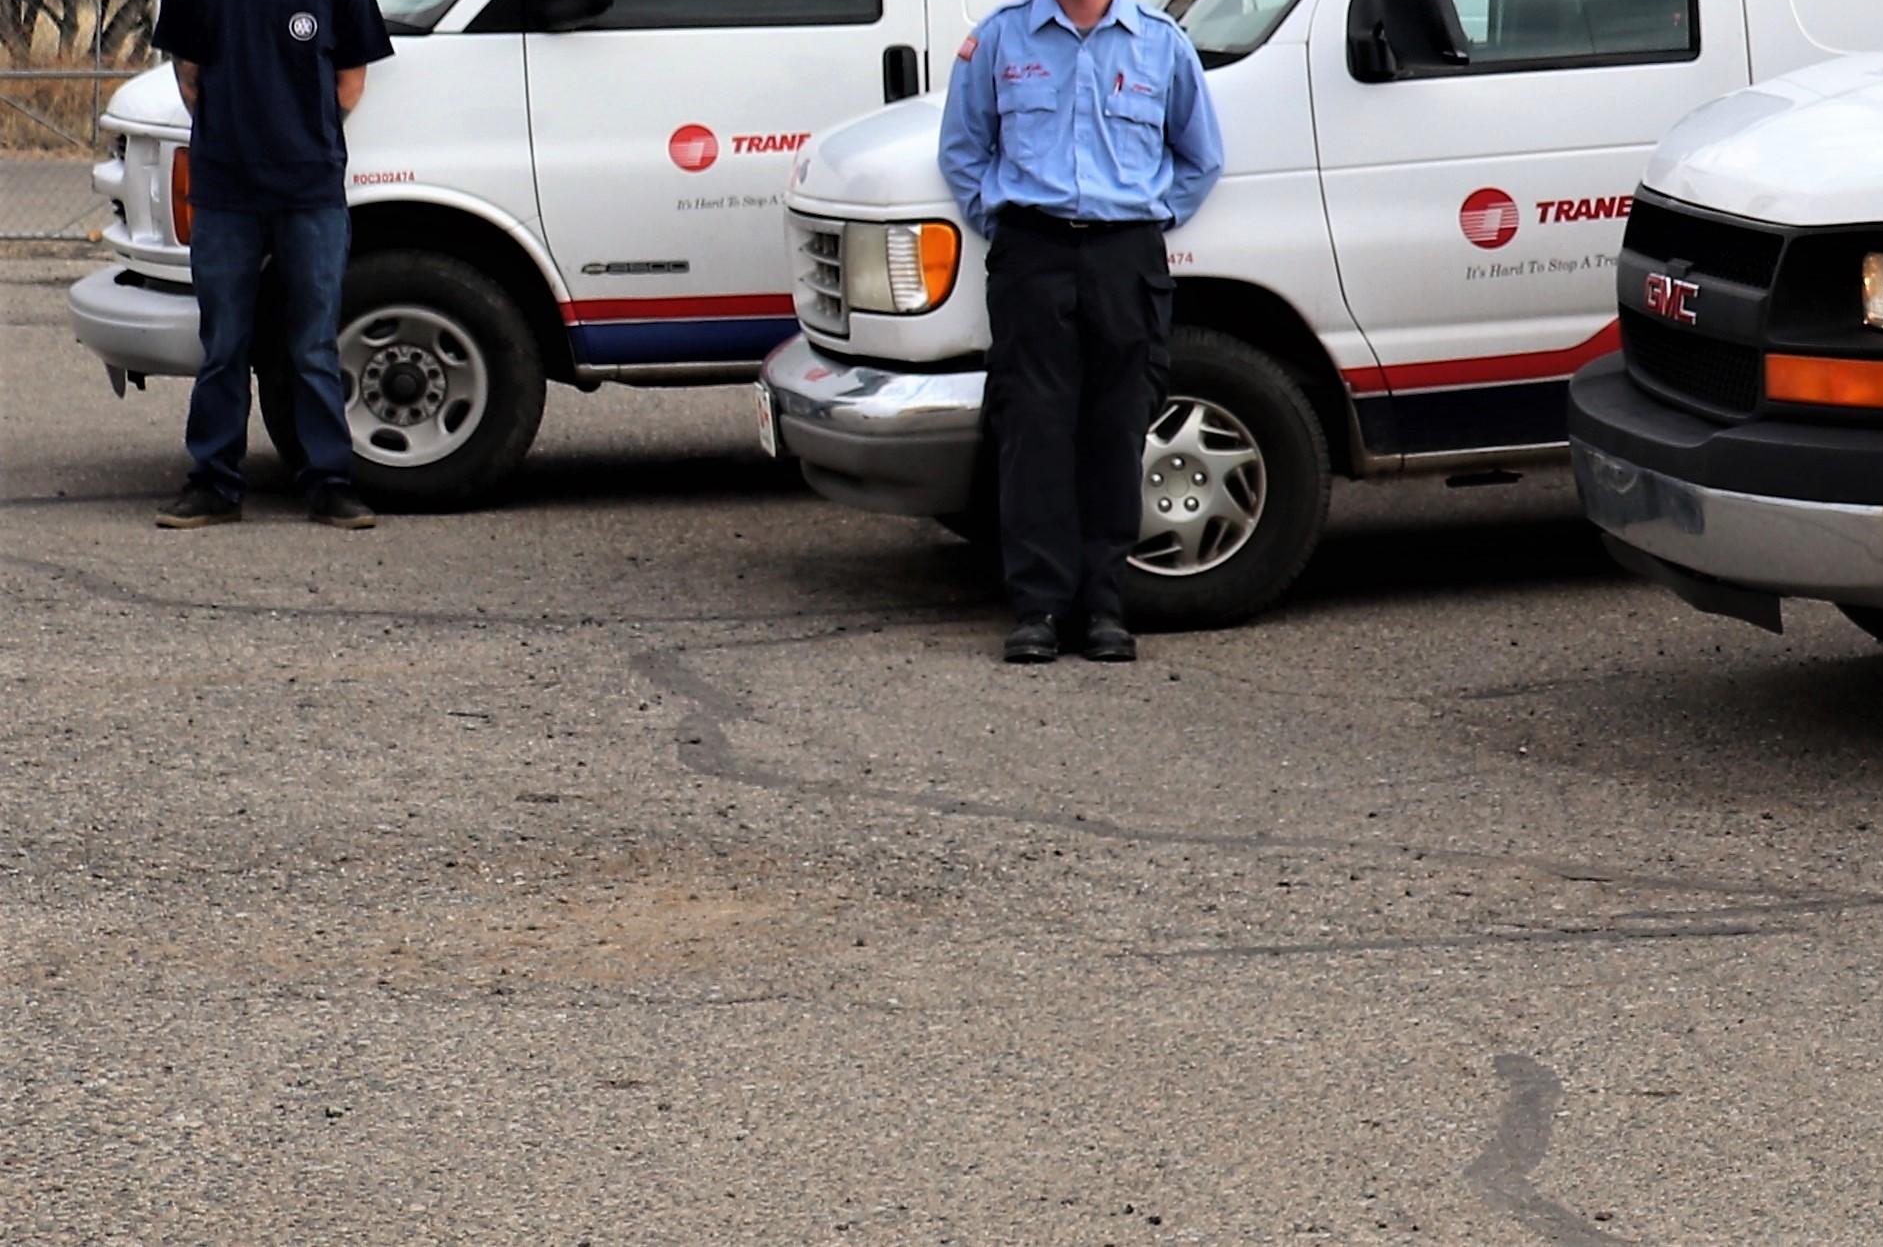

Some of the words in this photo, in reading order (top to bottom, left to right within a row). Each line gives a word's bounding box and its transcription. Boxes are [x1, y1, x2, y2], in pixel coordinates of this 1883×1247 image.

[1536, 195, 1635, 224] TRANE
[1466, 265, 1486, 281] It's
[1489, 262, 1524, 278] Hard
[1529, 259, 1545, 275] To
[1549, 257, 1577, 272] Stop
[1580, 256, 1591, 269] A
[1644, 272, 1699, 325] GMC
